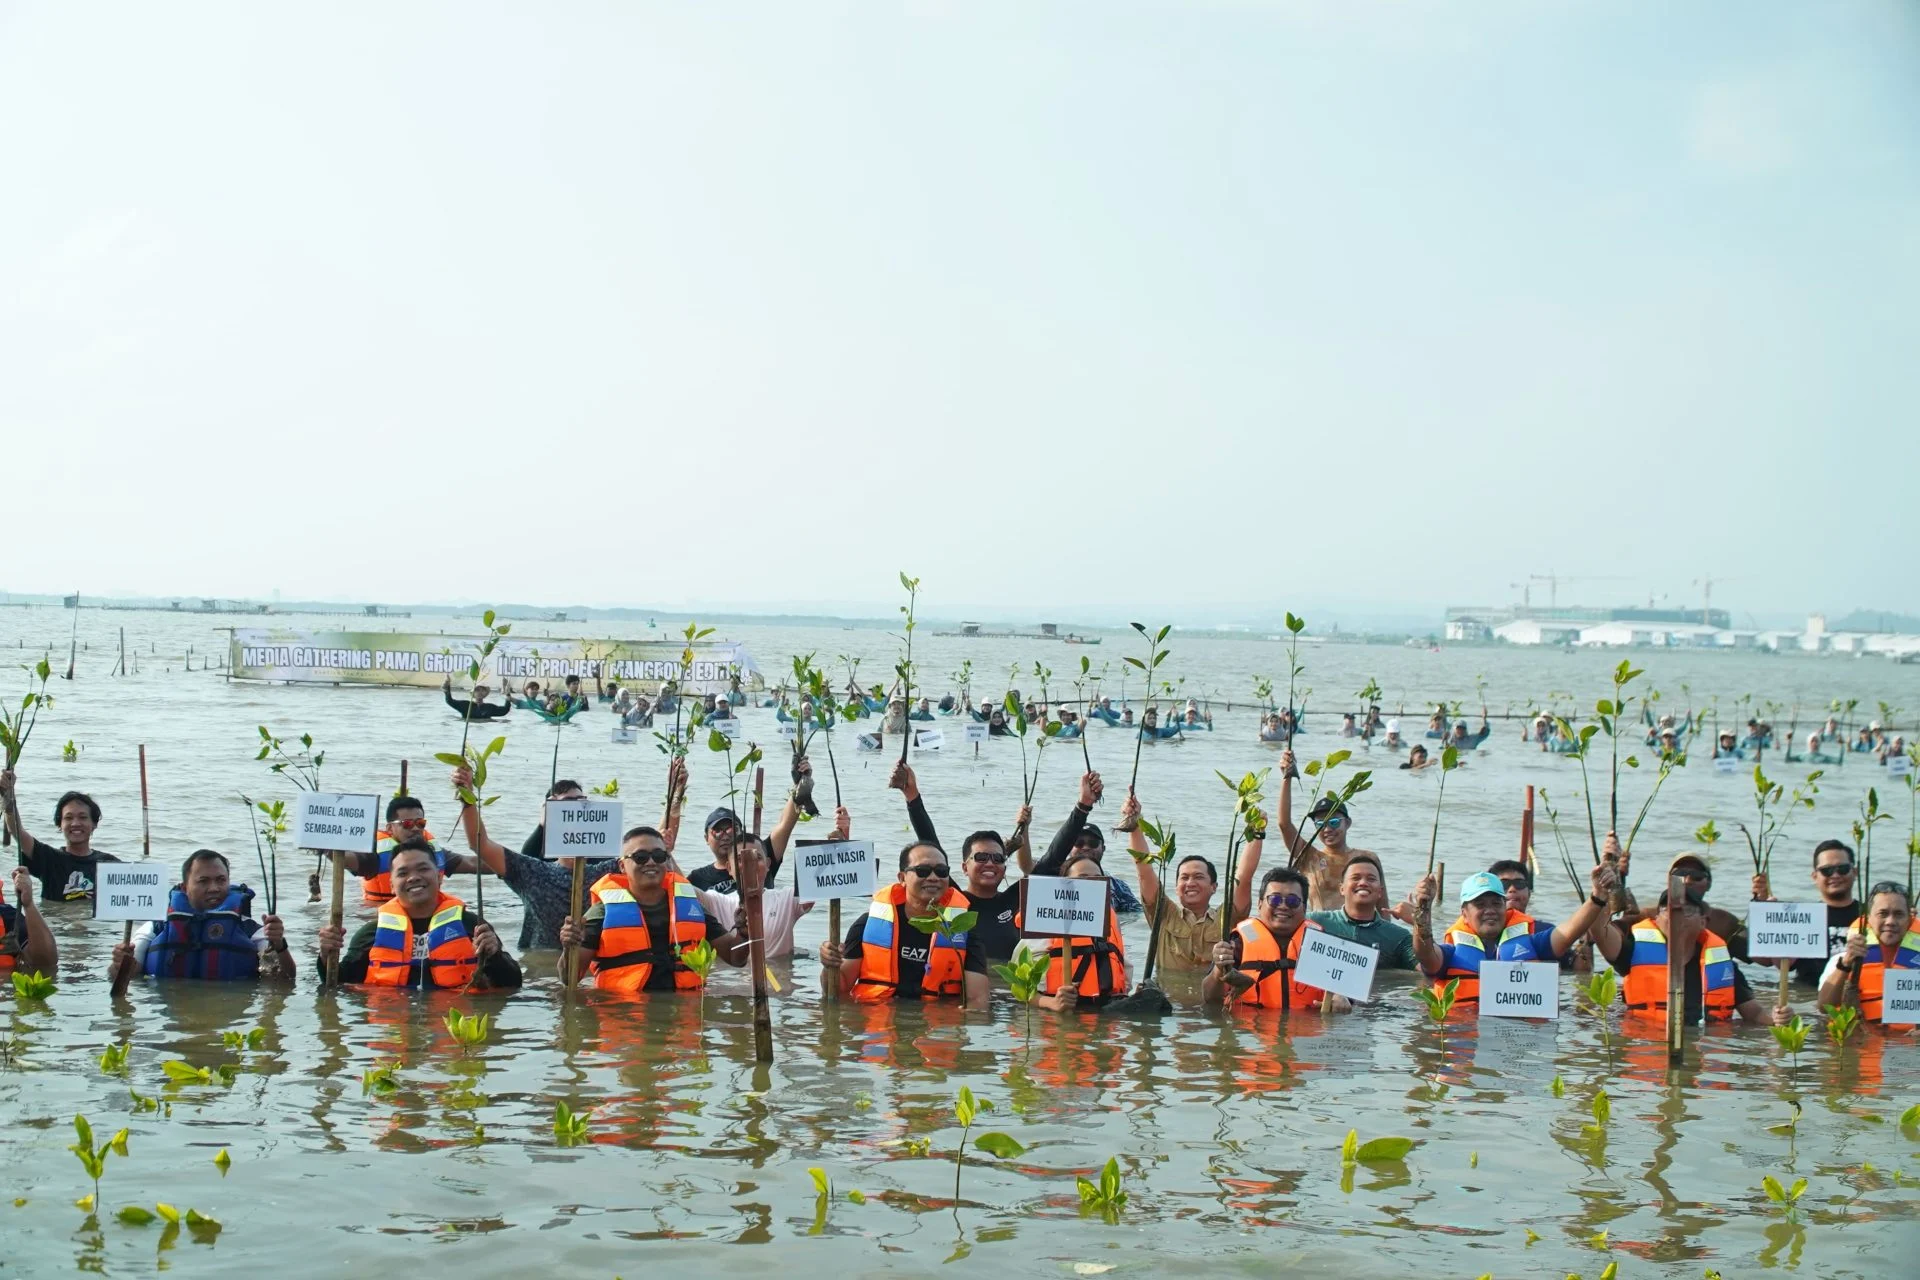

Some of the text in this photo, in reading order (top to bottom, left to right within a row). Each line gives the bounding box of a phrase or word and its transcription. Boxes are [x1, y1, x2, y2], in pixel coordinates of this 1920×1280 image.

[241, 647, 474, 674] MEDIA GATHERING PAMA GROUP
[539, 658, 605, 679] PROJECT
[608, 659, 693, 681] MANGROVE
[308, 805, 365, 818] DANIEL ANGGA
[562, 810, 608, 823] TH PUGUH
[304, 823, 342, 835] SEMBARA
[349, 826, 366, 836] KPP
[562, 832, 606, 845] SASETYO
[805, 850, 866, 868] ABDUL NASIR
[816, 872, 859, 888] MAKSUM
[110, 895, 129, 907] RUM
[137, 895, 153, 907] TTA
[1054, 889, 1080, 901] VANIA
[1036, 907, 1095, 922] HERLAMBANG
[1765, 911, 1812, 924] HIMAWAN
[1757, 932, 1799, 945] SUTANTO
[1807, 933, 1819, 945] UT
[901, 945, 928, 959] EA7
[1310, 941, 1369, 968] ARI SUTRISNO
[1331, 968, 1344, 981] UT
[1509, 970, 1529, 983] EDY
[1896, 979, 1912, 991] EKO
[1495, 992, 1542, 1006] CAHYONO
